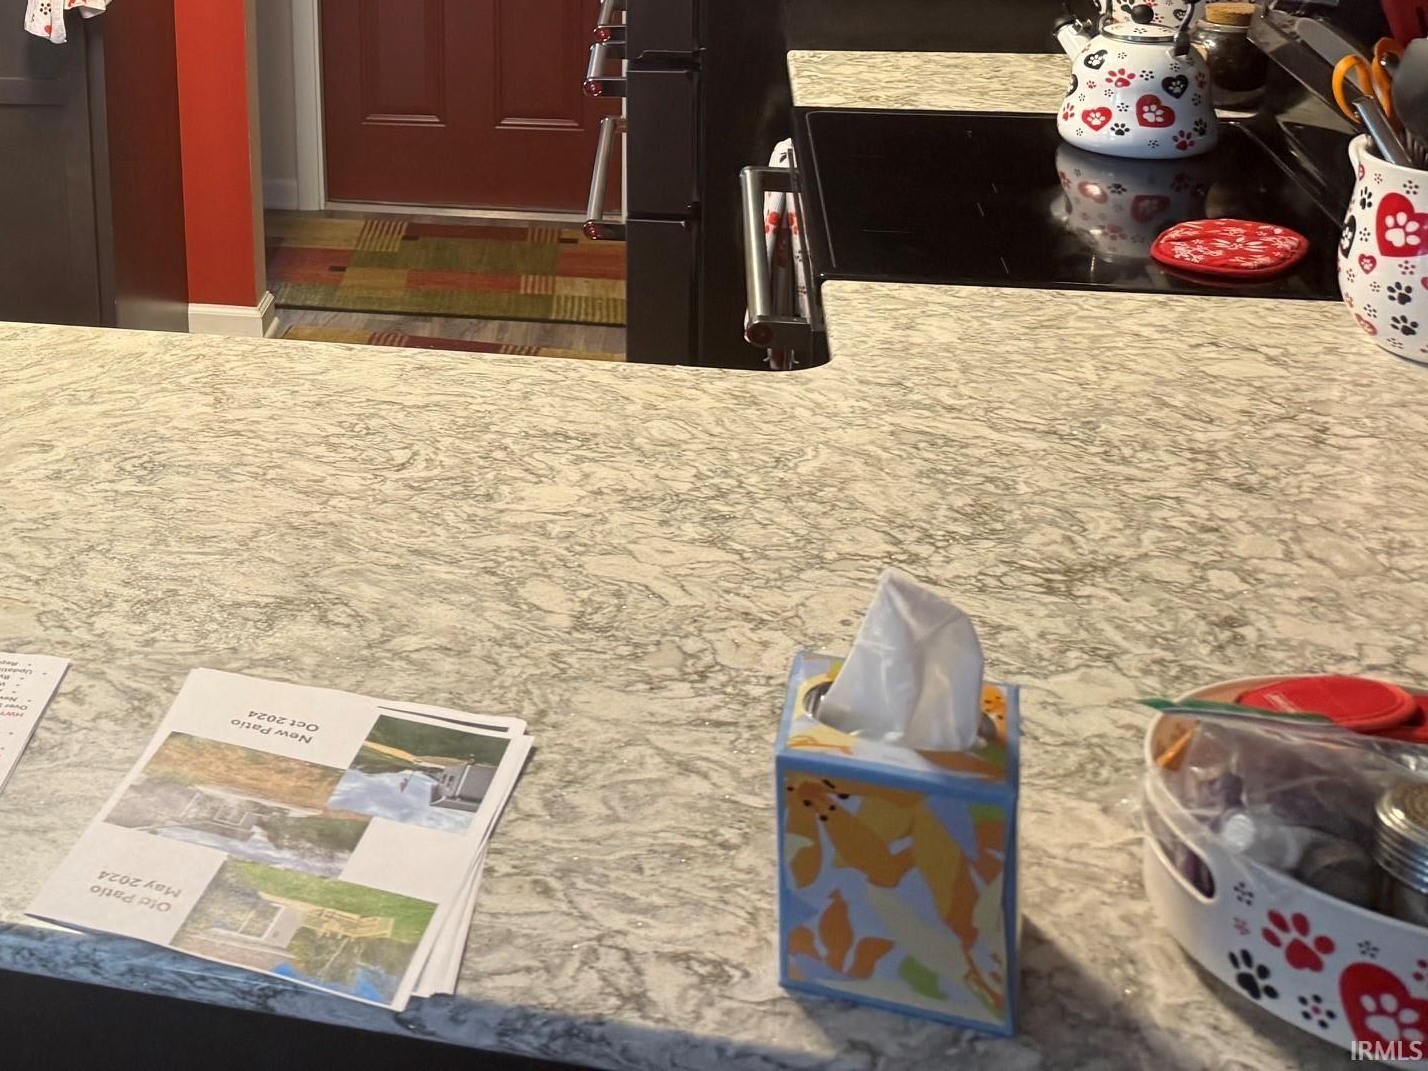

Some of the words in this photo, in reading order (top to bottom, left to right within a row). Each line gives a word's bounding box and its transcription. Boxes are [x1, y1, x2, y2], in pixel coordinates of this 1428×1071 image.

[248, 711, 287, 724] 2024
[231, 719, 272, 734] Patio
[290, 720, 319, 732] Oct
[275, 730, 312, 743] New
[98, 871, 142, 887] 2024
[90, 885, 135, 903] Patio
[143, 881, 181, 898] May
[139, 897, 171, 912] Old
